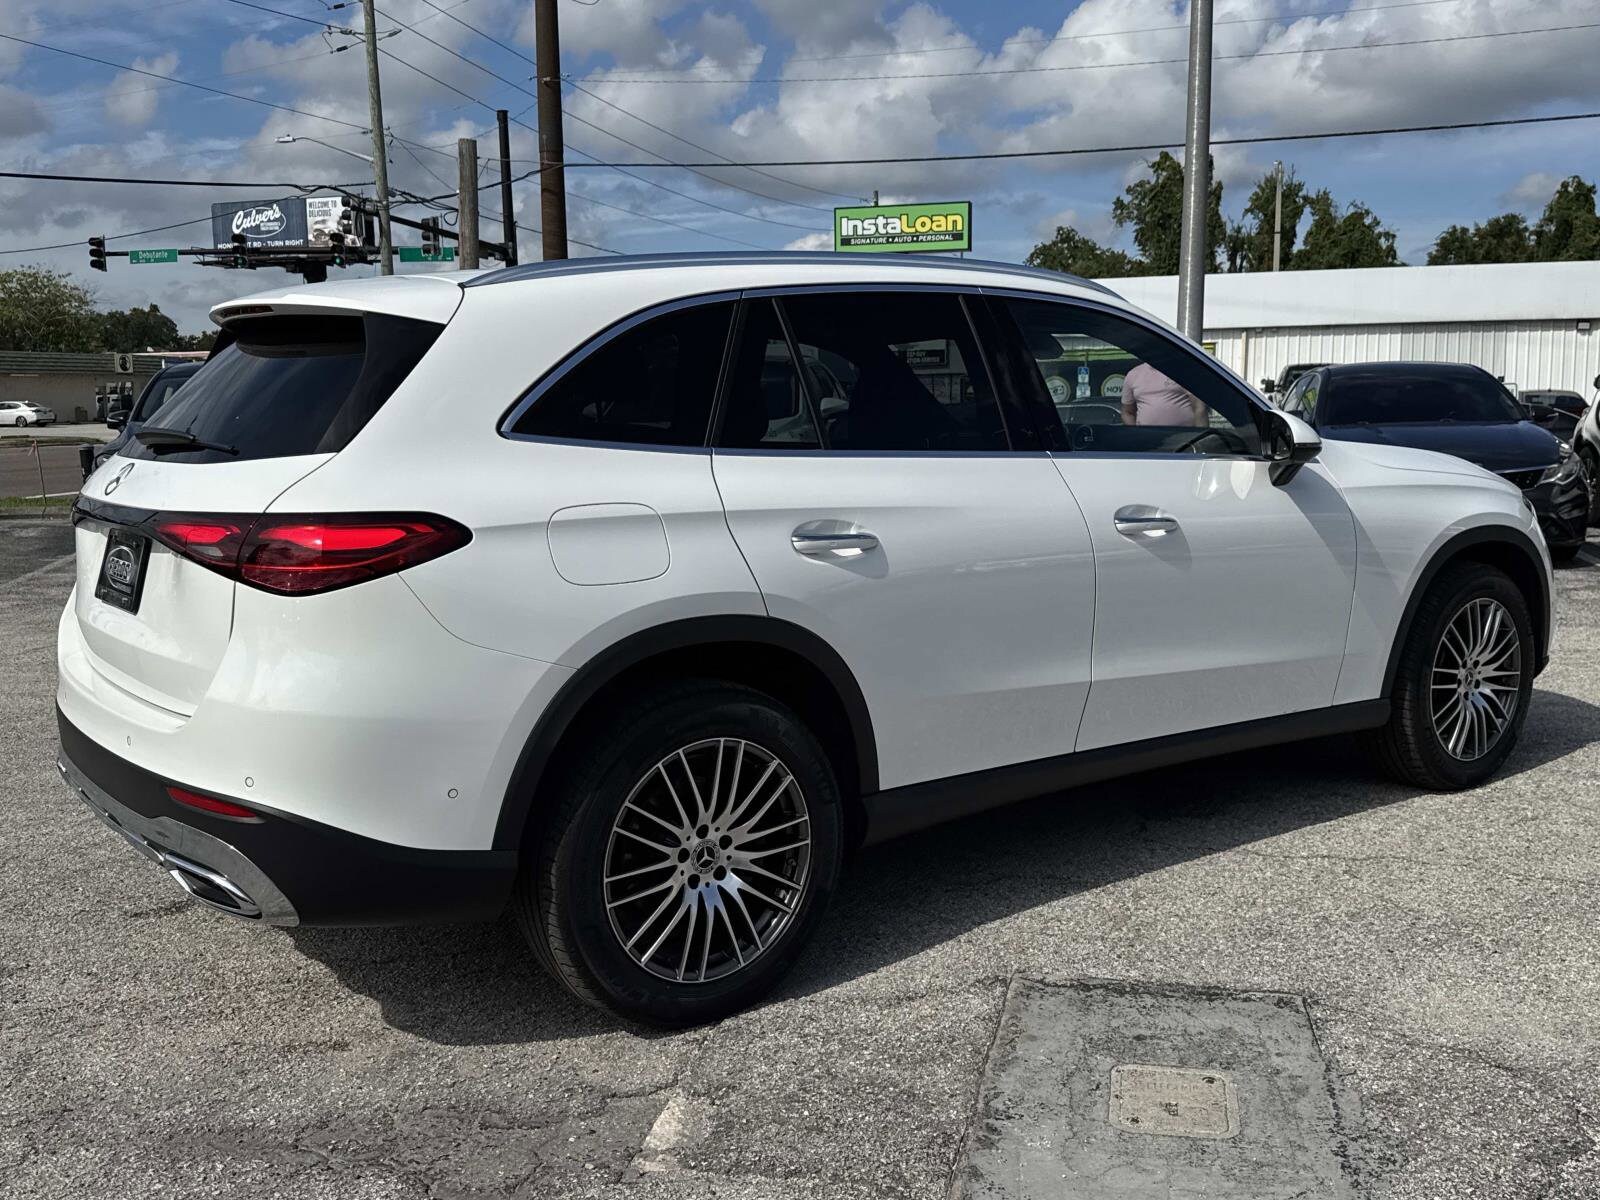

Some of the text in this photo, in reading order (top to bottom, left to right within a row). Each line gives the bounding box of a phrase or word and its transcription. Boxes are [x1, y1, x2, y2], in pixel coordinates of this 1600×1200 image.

[308, 199, 338, 210] WELCOME TO
[231, 204, 281, 235] Culver's
[308, 209, 332, 218] DELICIOUS
[841, 214, 963, 236] InstaLoan
[850, 233, 954, 245] SIGNATURE AUTO PERSONAL
